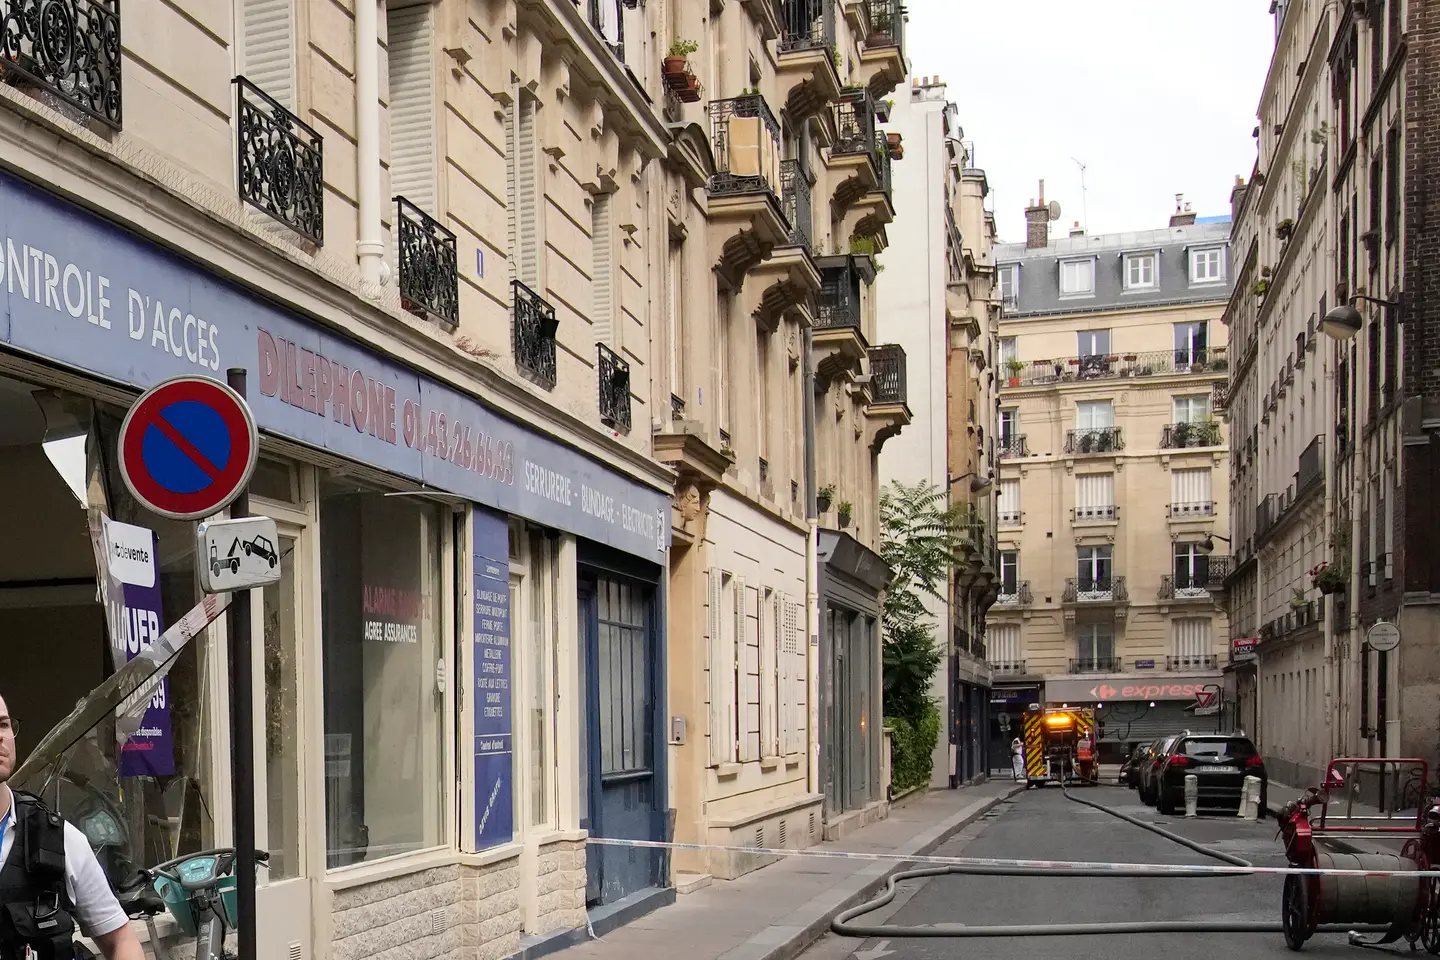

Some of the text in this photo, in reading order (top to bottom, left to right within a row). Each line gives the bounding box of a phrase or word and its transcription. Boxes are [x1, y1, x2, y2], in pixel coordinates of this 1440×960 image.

[128, 287, 221, 372] D'ACCES
[257, 326, 397, 446] DILEPHONE
[525, 460, 571, 506] SERRURERIE
[581, 484, 614, 525] BLINDAGE
[622, 503, 654, 541] ELECTRICITE
[364, 621, 417, 643] AGREE ASSURANCES
[1121, 684, 1204, 699] express
